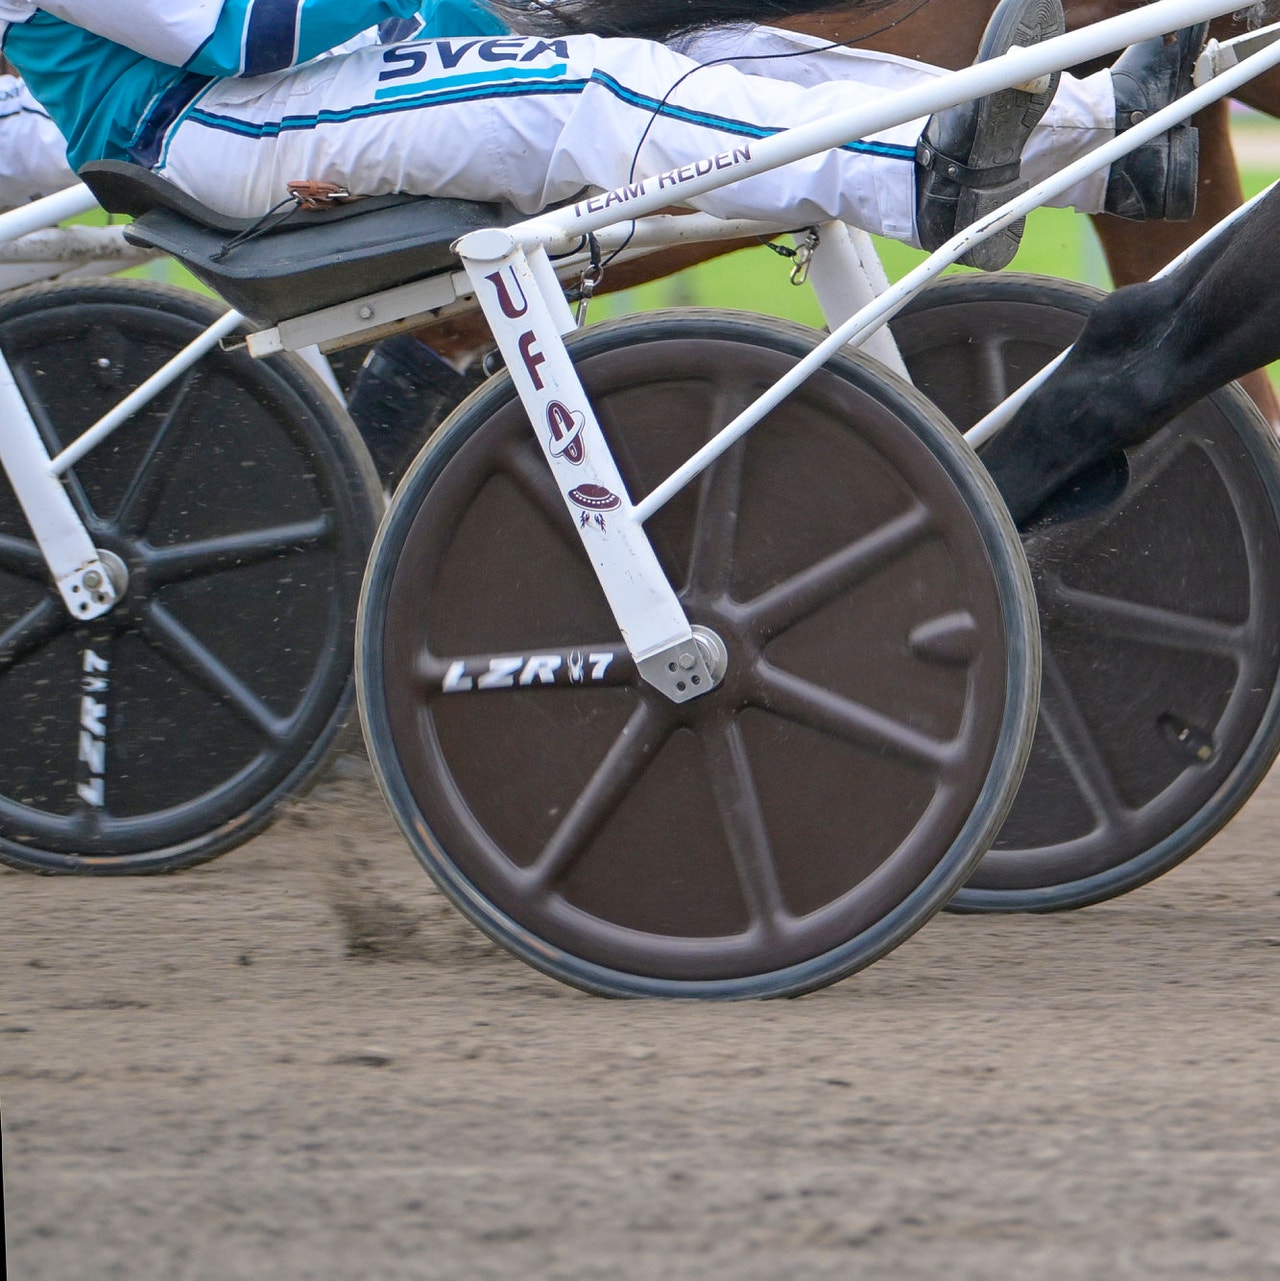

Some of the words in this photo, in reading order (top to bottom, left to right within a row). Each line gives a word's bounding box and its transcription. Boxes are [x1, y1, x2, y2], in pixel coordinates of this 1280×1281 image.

[378, 35, 570, 82] SVEA
[574, 181, 647, 218] TEAM
[441, 655, 563, 694] LZR
